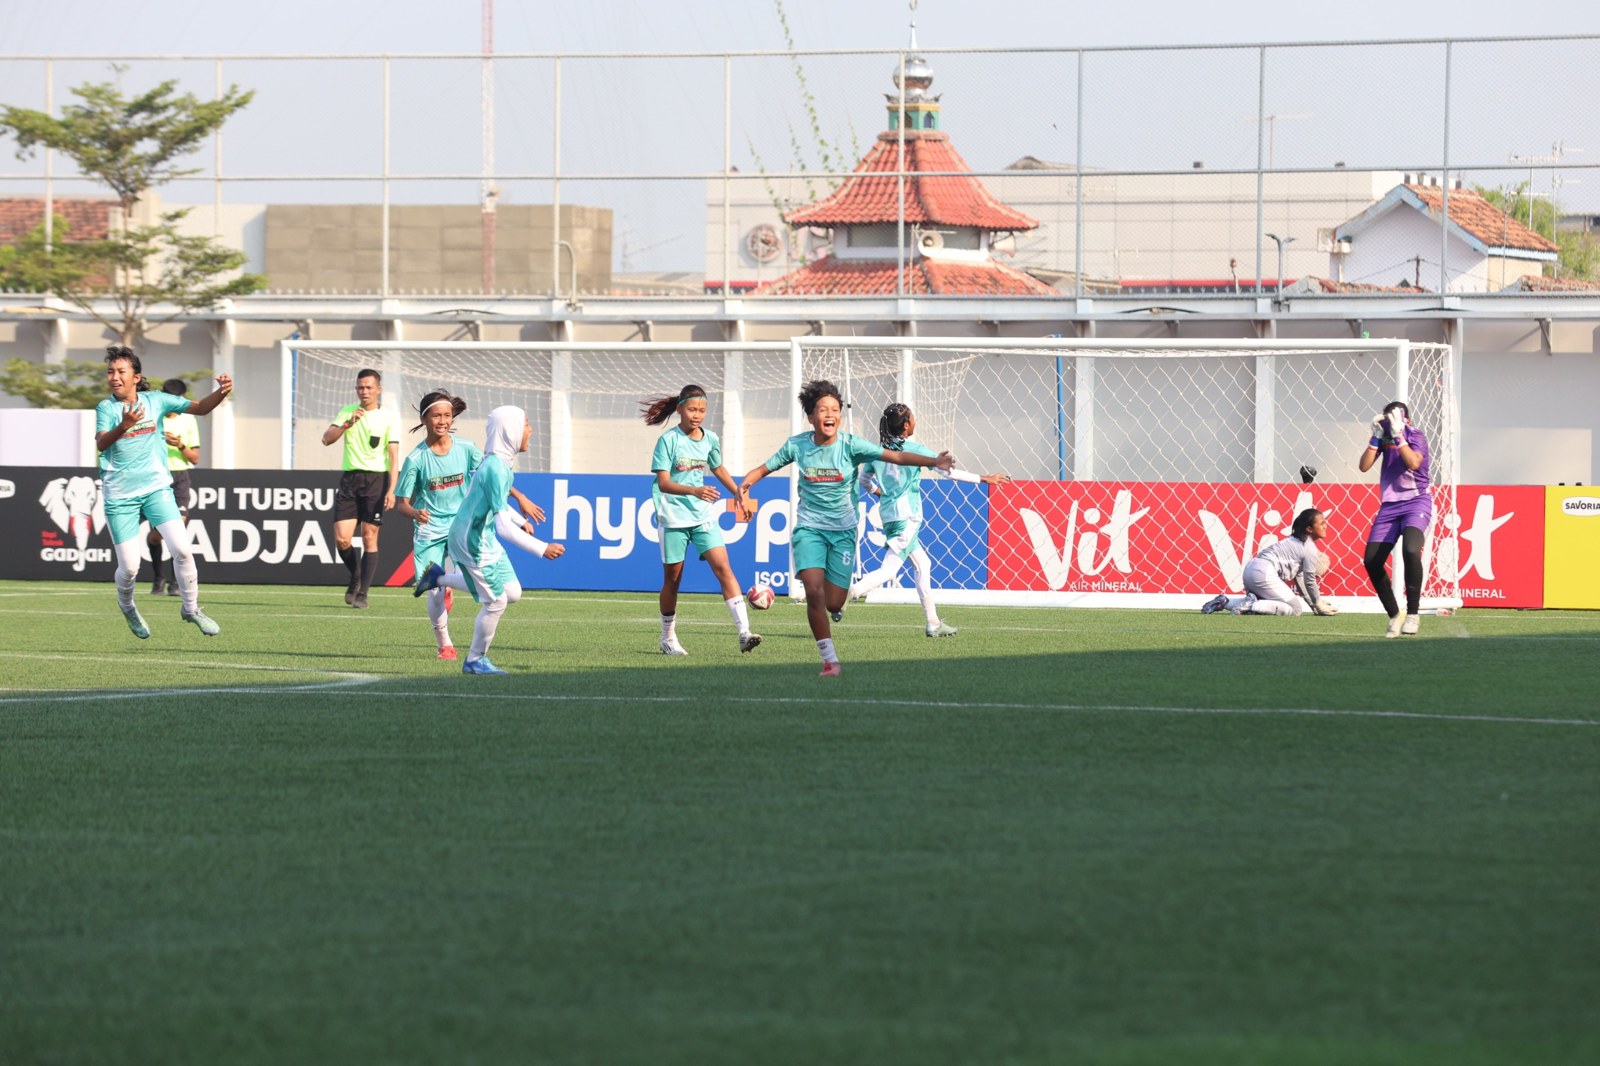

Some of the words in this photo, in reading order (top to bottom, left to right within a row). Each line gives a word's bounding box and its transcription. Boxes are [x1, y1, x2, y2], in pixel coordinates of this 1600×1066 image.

[188, 487, 226, 510] PI
[233, 487, 338, 511] TUBRU
[1565, 500, 1600, 510] SAVORIA
[552, 478, 888, 563] hyops
[1019, 489, 1151, 591] Vit
[1070, 581, 1089, 591] AIR
[1091, 581, 1141, 592] MINERAL
[1458, 588, 1506, 599] INERAL
